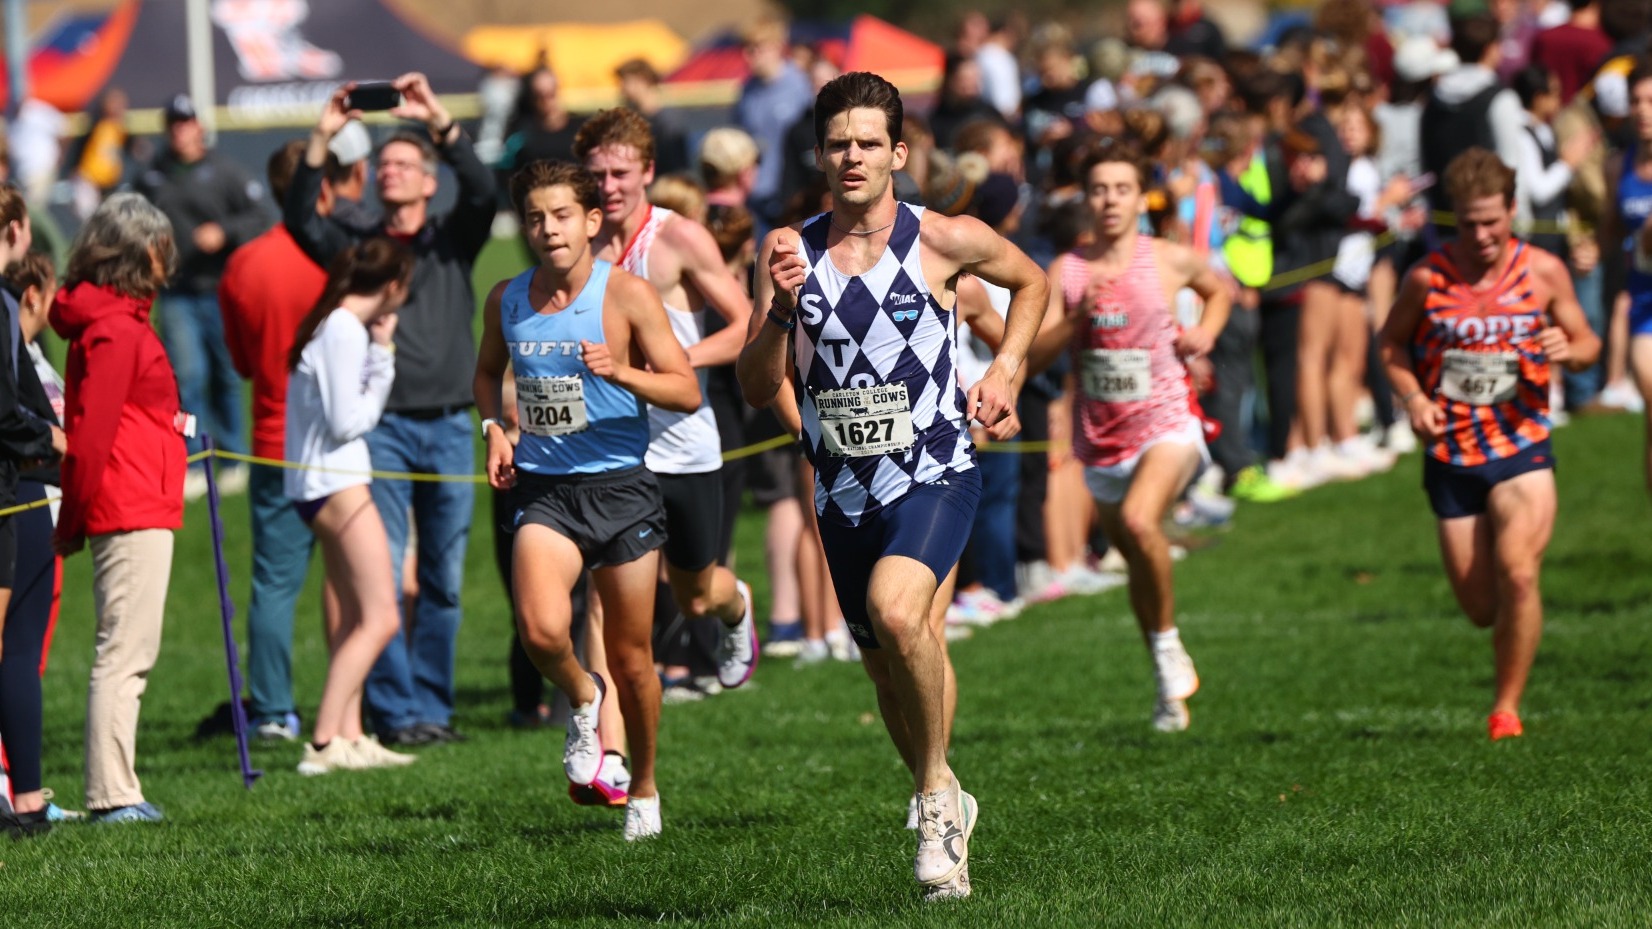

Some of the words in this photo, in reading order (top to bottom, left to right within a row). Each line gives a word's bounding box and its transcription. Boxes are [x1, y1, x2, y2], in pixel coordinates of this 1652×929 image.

[552, 382, 580, 393] COWS
[862, 387, 888, 396] COLLEGE
[1459, 376, 1497, 395] 467
[818, 396, 861, 409] RUNNING
[872, 390, 907, 404] COWS
[525, 405, 572, 426] 1204
[835, 418, 894, 446] 1627
